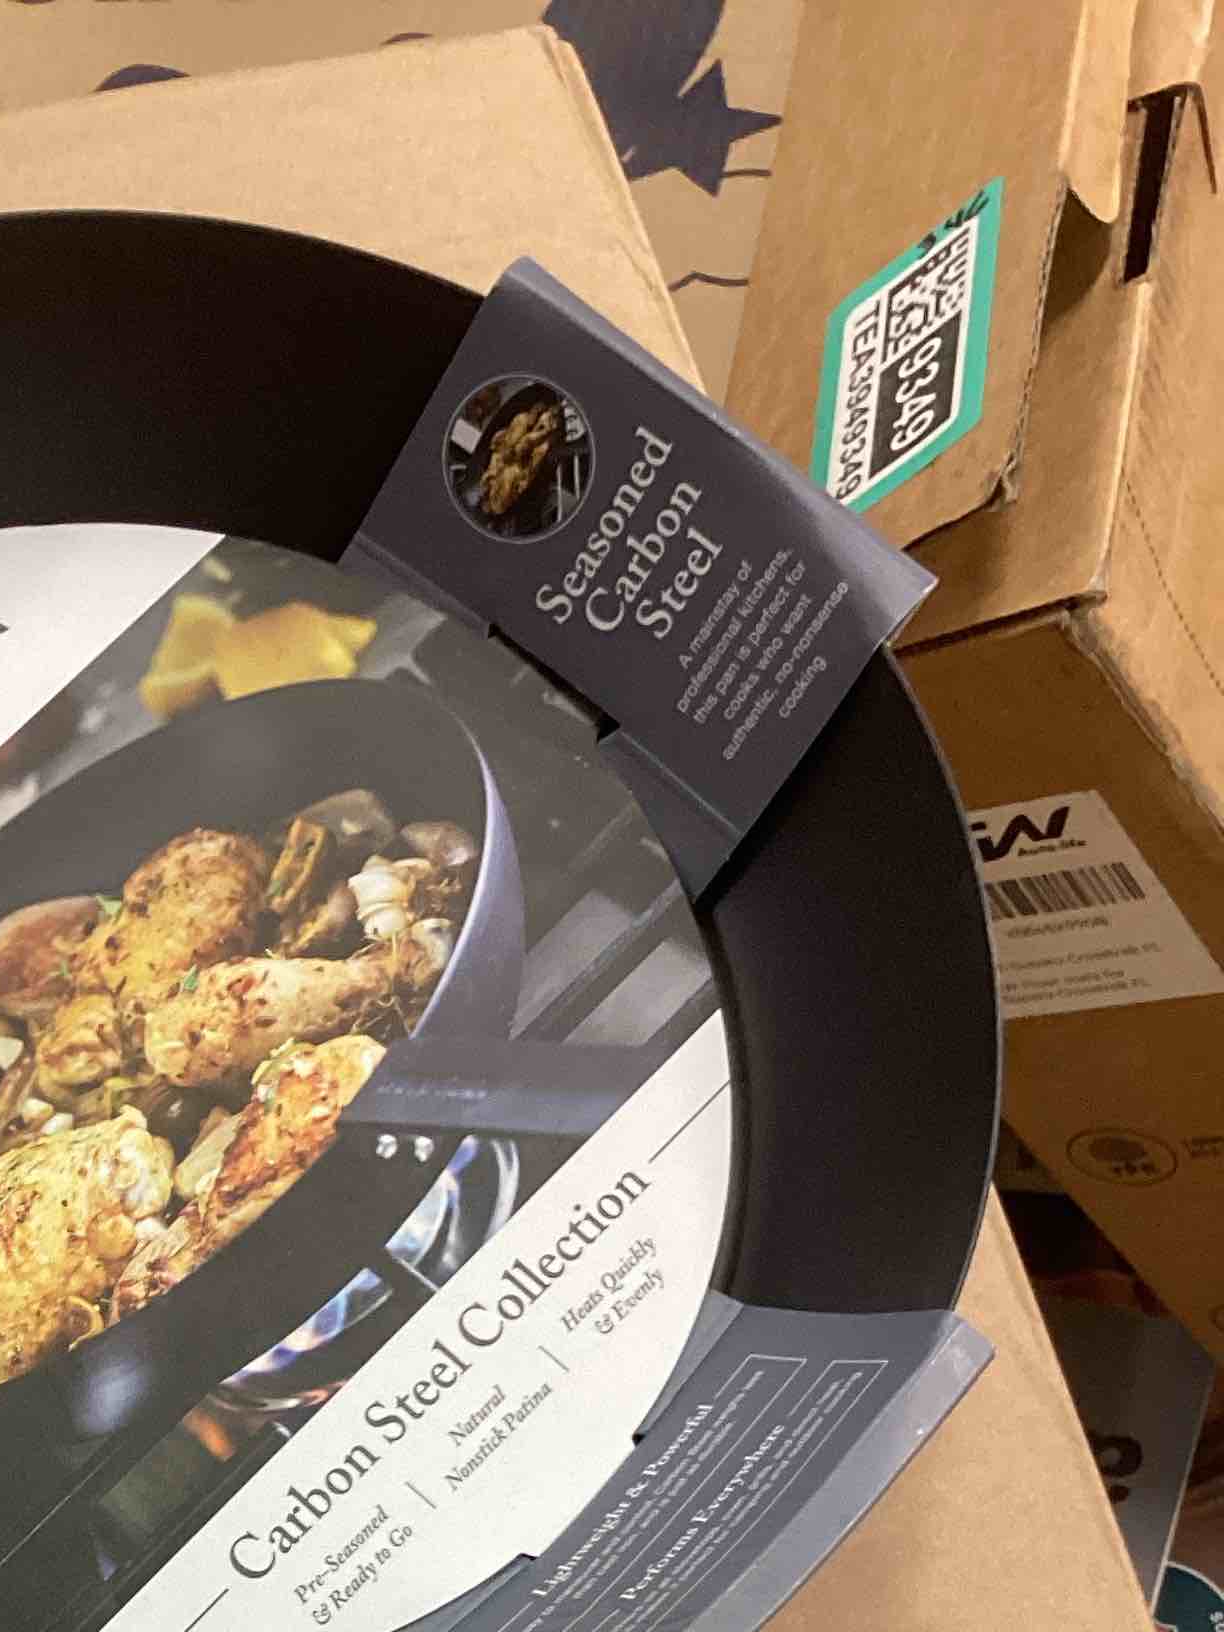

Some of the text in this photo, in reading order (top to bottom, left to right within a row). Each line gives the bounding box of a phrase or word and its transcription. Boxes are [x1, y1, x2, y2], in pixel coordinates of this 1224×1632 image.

[831, 298, 882, 500] TEA3949349
[889, 332, 944, 454] 9349
[535, 426, 673, 625] Seasoned
[585, 482, 702, 631] Carbon
[635, 527, 723, 639] Steel
[677, 558, 754, 669] A mainstay of
[772, 578, 851, 684] no-nonsense
[674, 616, 744, 714] professional
[691, 558, 808, 724] this pan is perfect for
[721, 592, 813, 722] cooks who want
[776, 654, 828, 720] cooking
[558, 1237, 657, 1333] Heats Quickly
[594, 1269, 665, 1335] & Evenly
[229, 1444, 381, 1579] Carbon
[364, 1339, 473, 1445] Steel
[458, 1171, 652, 1348] Collection
[446, 1383, 508, 1448] Natural
[444, 1383, 553, 1491] Nonstick Patina
[292, 1504, 390, 1605] Pre-Seasoned
[530, 1498, 632, 1600] Lightweight
[624, 1477, 650, 1500] &
[642, 1400, 715, 1479] Powerful
[618, 1524, 700, 1604] Performs
[690, 1421, 788, 1526] Everywhere
[312, 1522, 415, 1626] & Ready to Go
